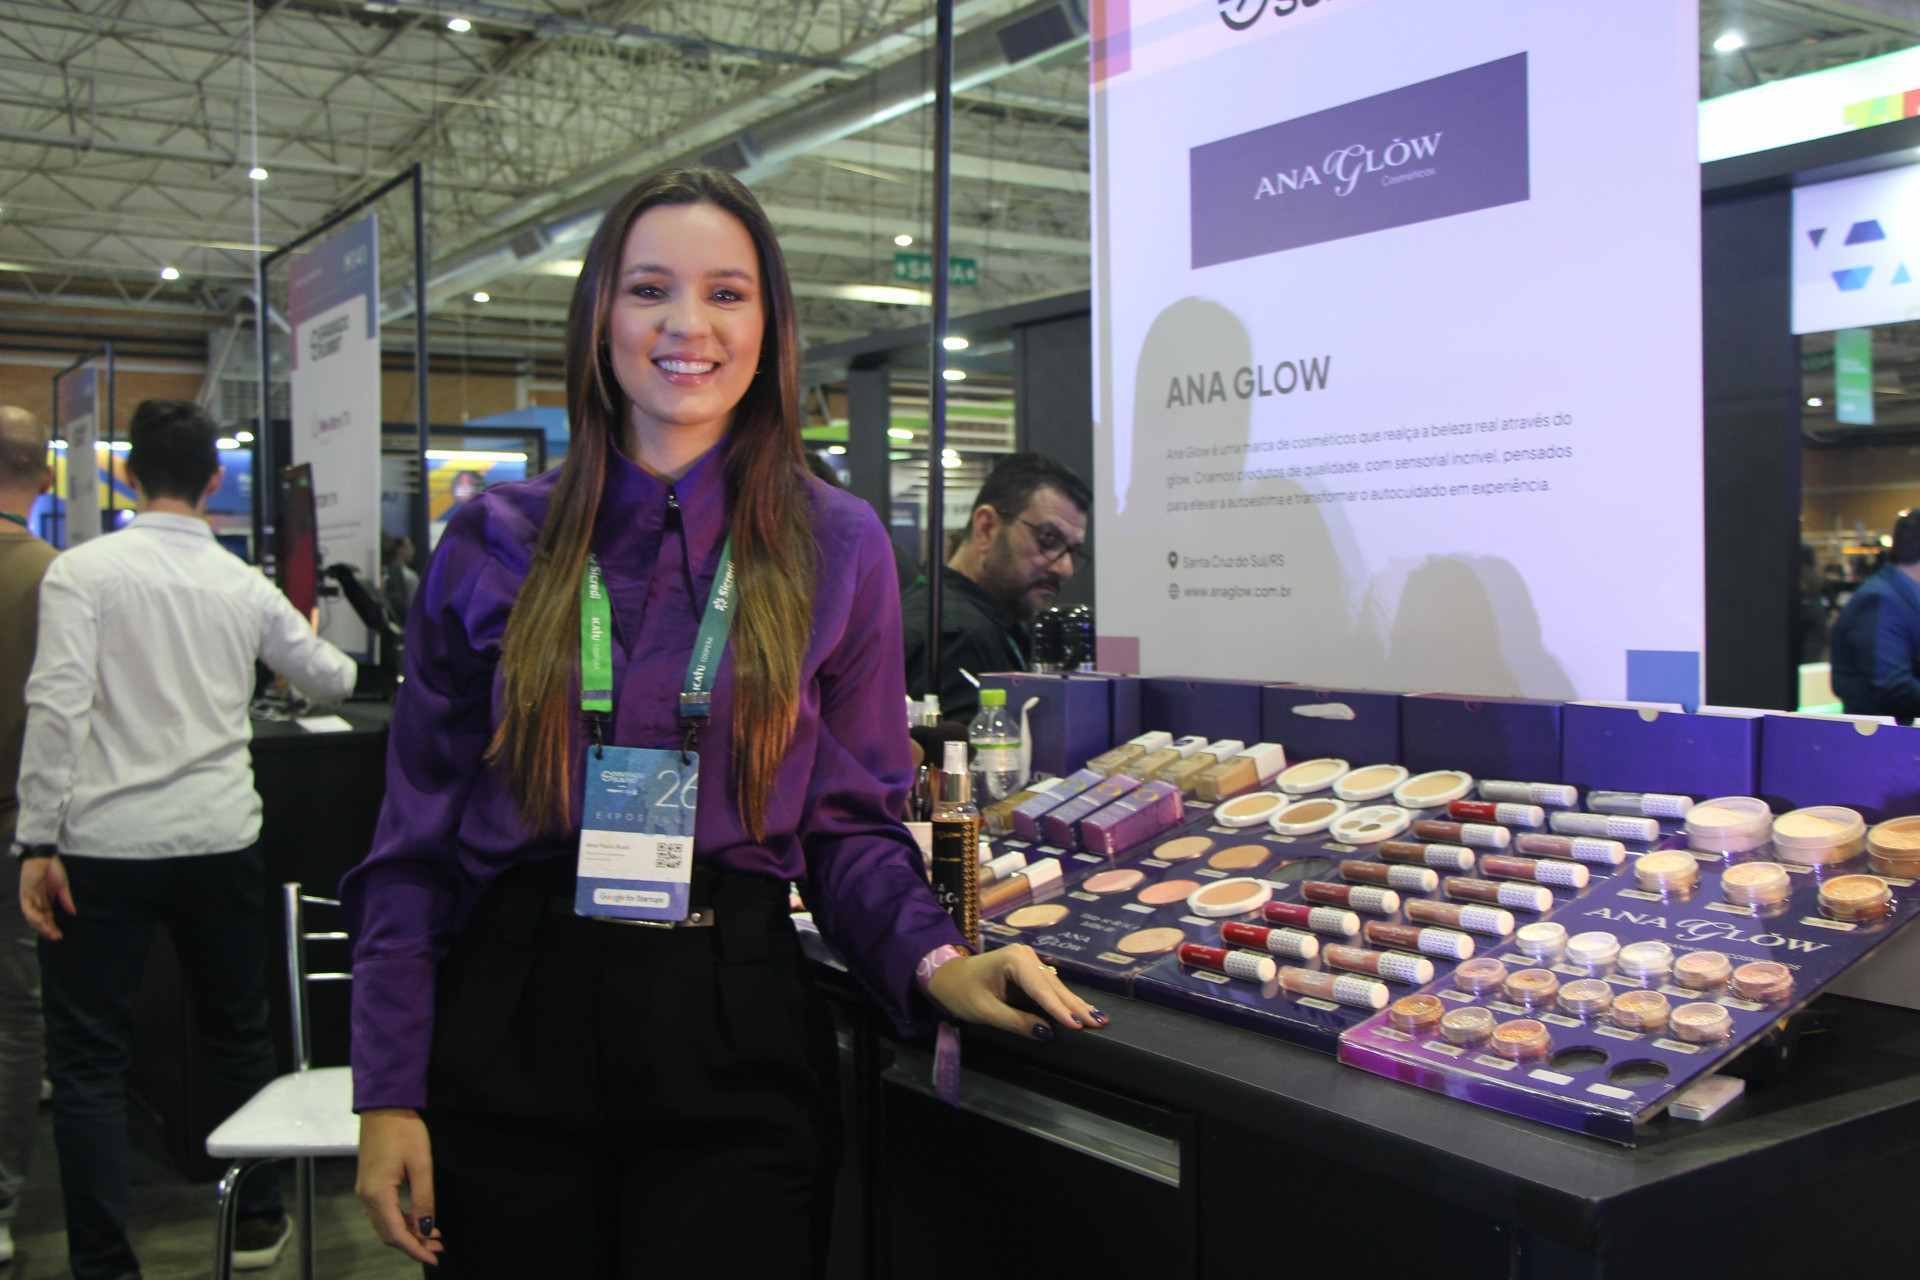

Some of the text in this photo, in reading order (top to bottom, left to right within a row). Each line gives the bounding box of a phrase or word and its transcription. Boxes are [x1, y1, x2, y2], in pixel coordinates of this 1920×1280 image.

[1254, 165, 1323, 200] ANA
[1165, 355, 1331, 409] ANA GLOW
[1359, 431, 1381, 447] que
[1431, 418, 1473, 438] beleza
[1475, 416, 1498, 432] real
[1501, 411, 1550, 431] através
[1553, 411, 1573, 427] do
[1503, 443, 1573, 465] pensados
[1449, 484, 1469, 497] em
[1583, 907, 1831, 953] ANA GLOW
